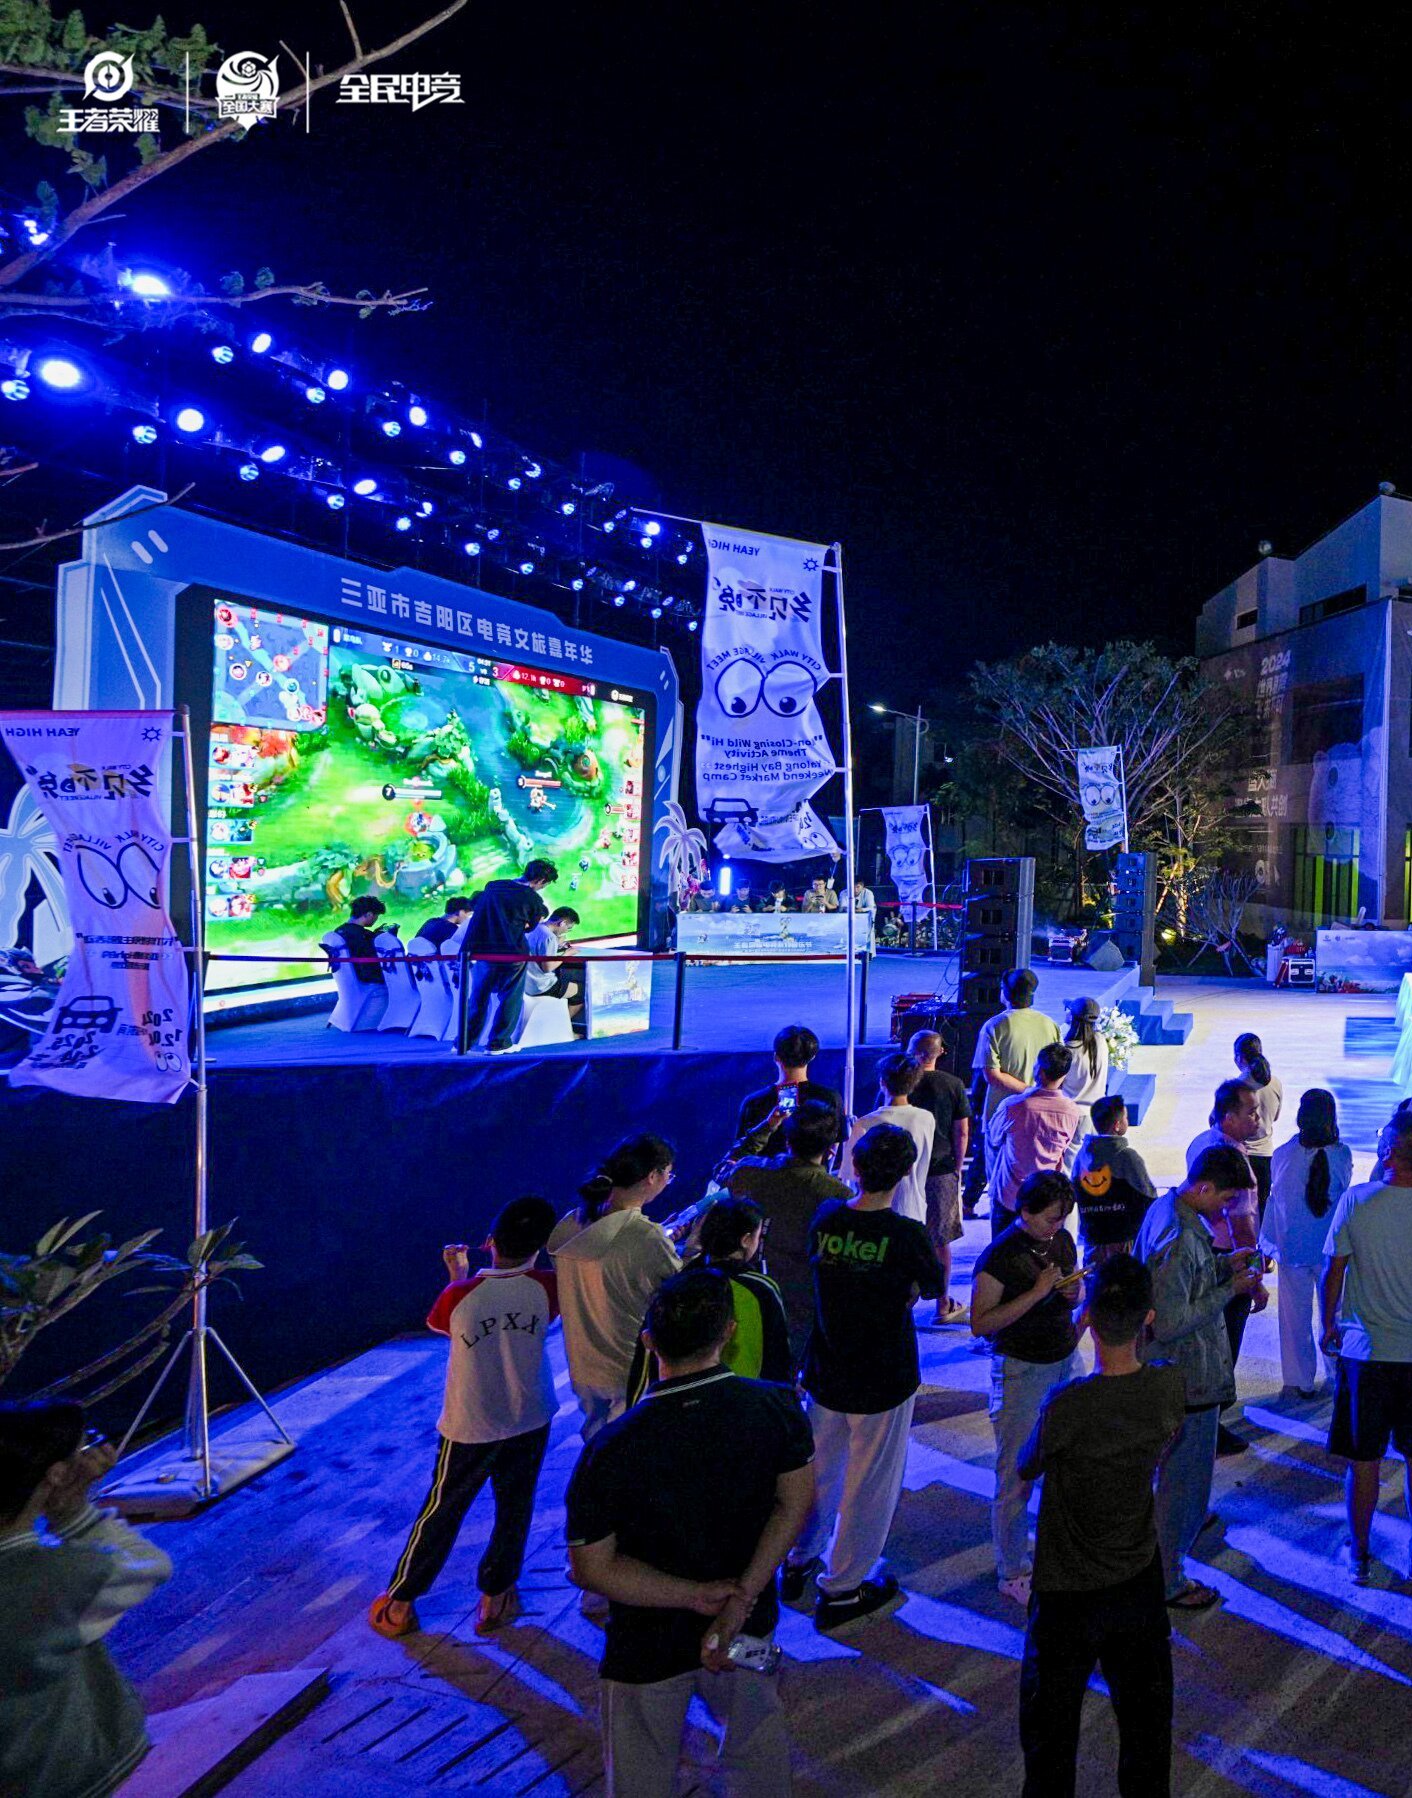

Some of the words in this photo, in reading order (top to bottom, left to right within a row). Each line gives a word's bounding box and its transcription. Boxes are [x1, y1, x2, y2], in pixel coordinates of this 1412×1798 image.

[340, 577, 594, 666] 三亚市吉阳区电竞文旅嘉年华
[468, 662, 475, 672] 5
[492, 666, 499, 677] 3
[1260, 649, 1292, 677] 2024
[816, 1231, 890, 1263] yokel
